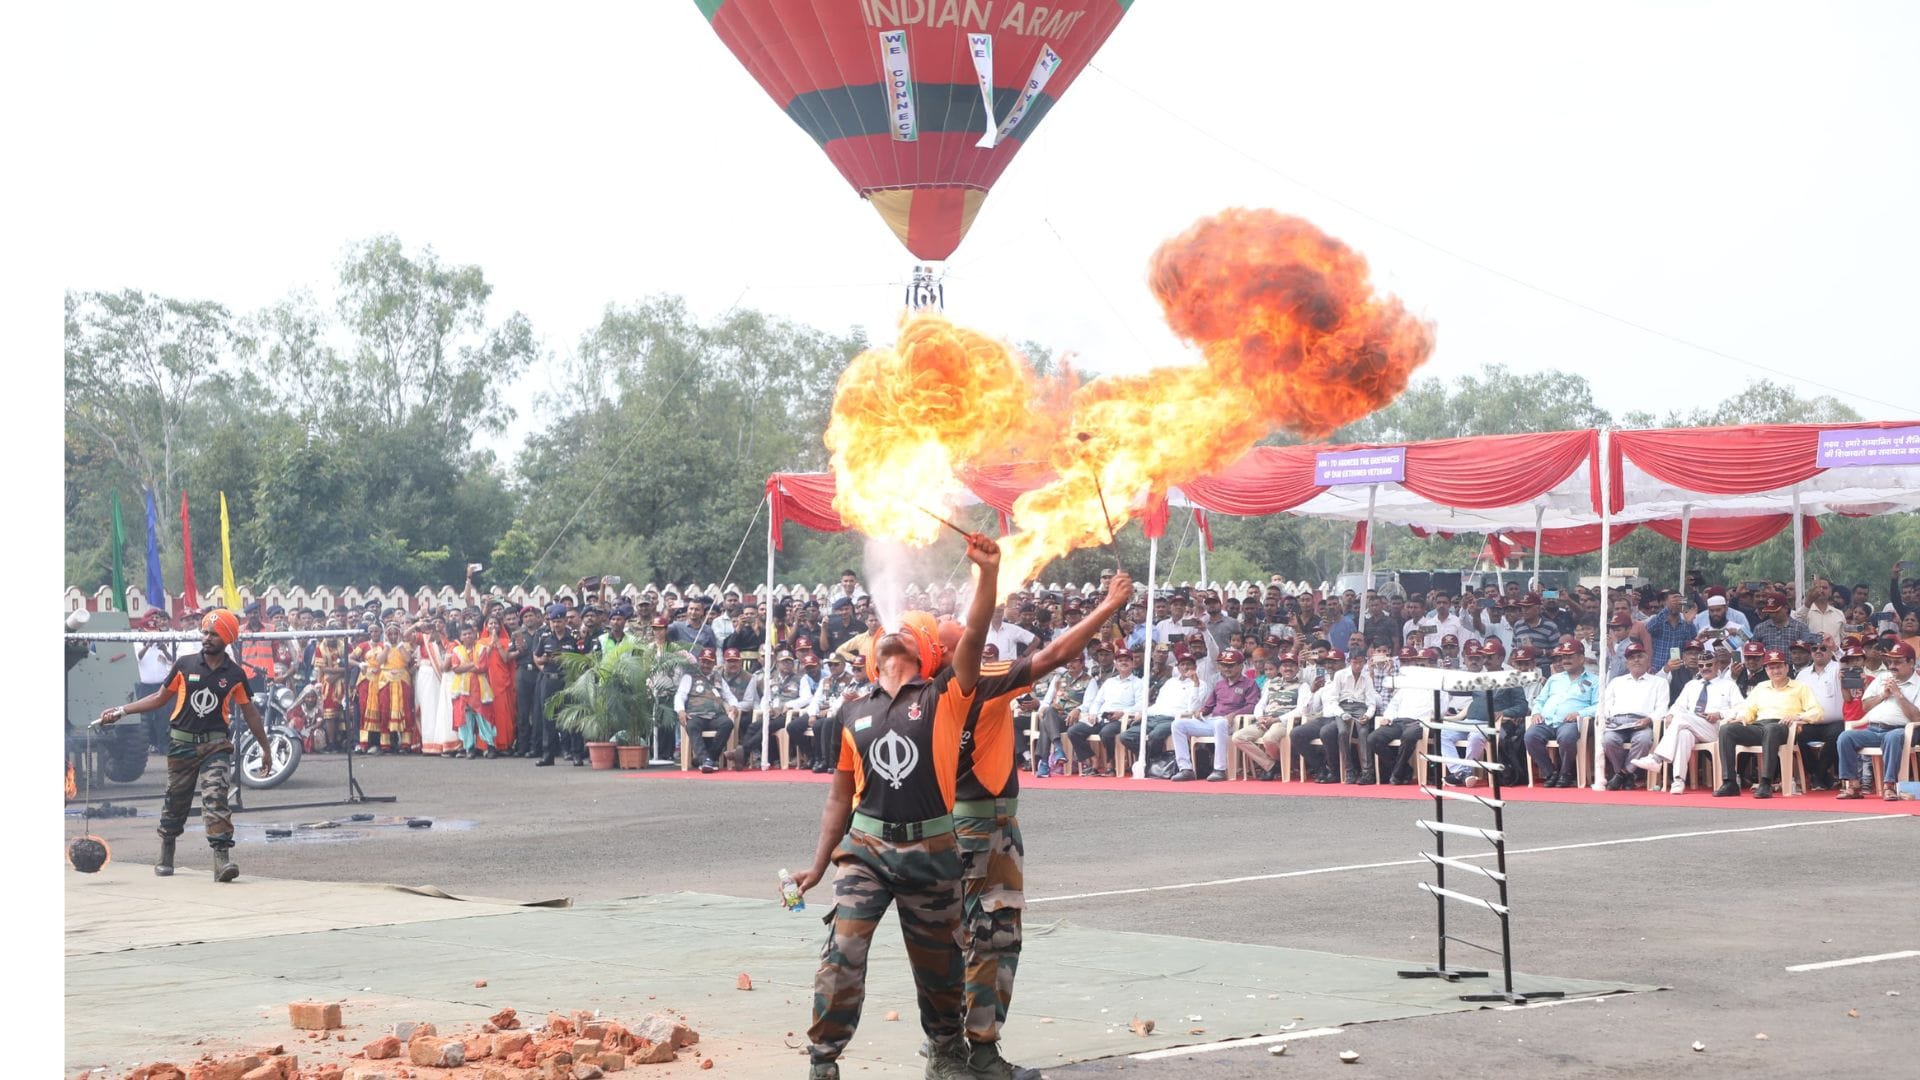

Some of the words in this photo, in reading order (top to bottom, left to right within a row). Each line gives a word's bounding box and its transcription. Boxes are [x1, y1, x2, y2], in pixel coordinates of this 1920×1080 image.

[861, 0, 992, 30] INDIAN
[1000, 2, 1086, 40] ARMY
[885, 35, 901, 54] WE
[971, 37, 987, 58] WE
[892, 69, 912, 138] CONNECT
